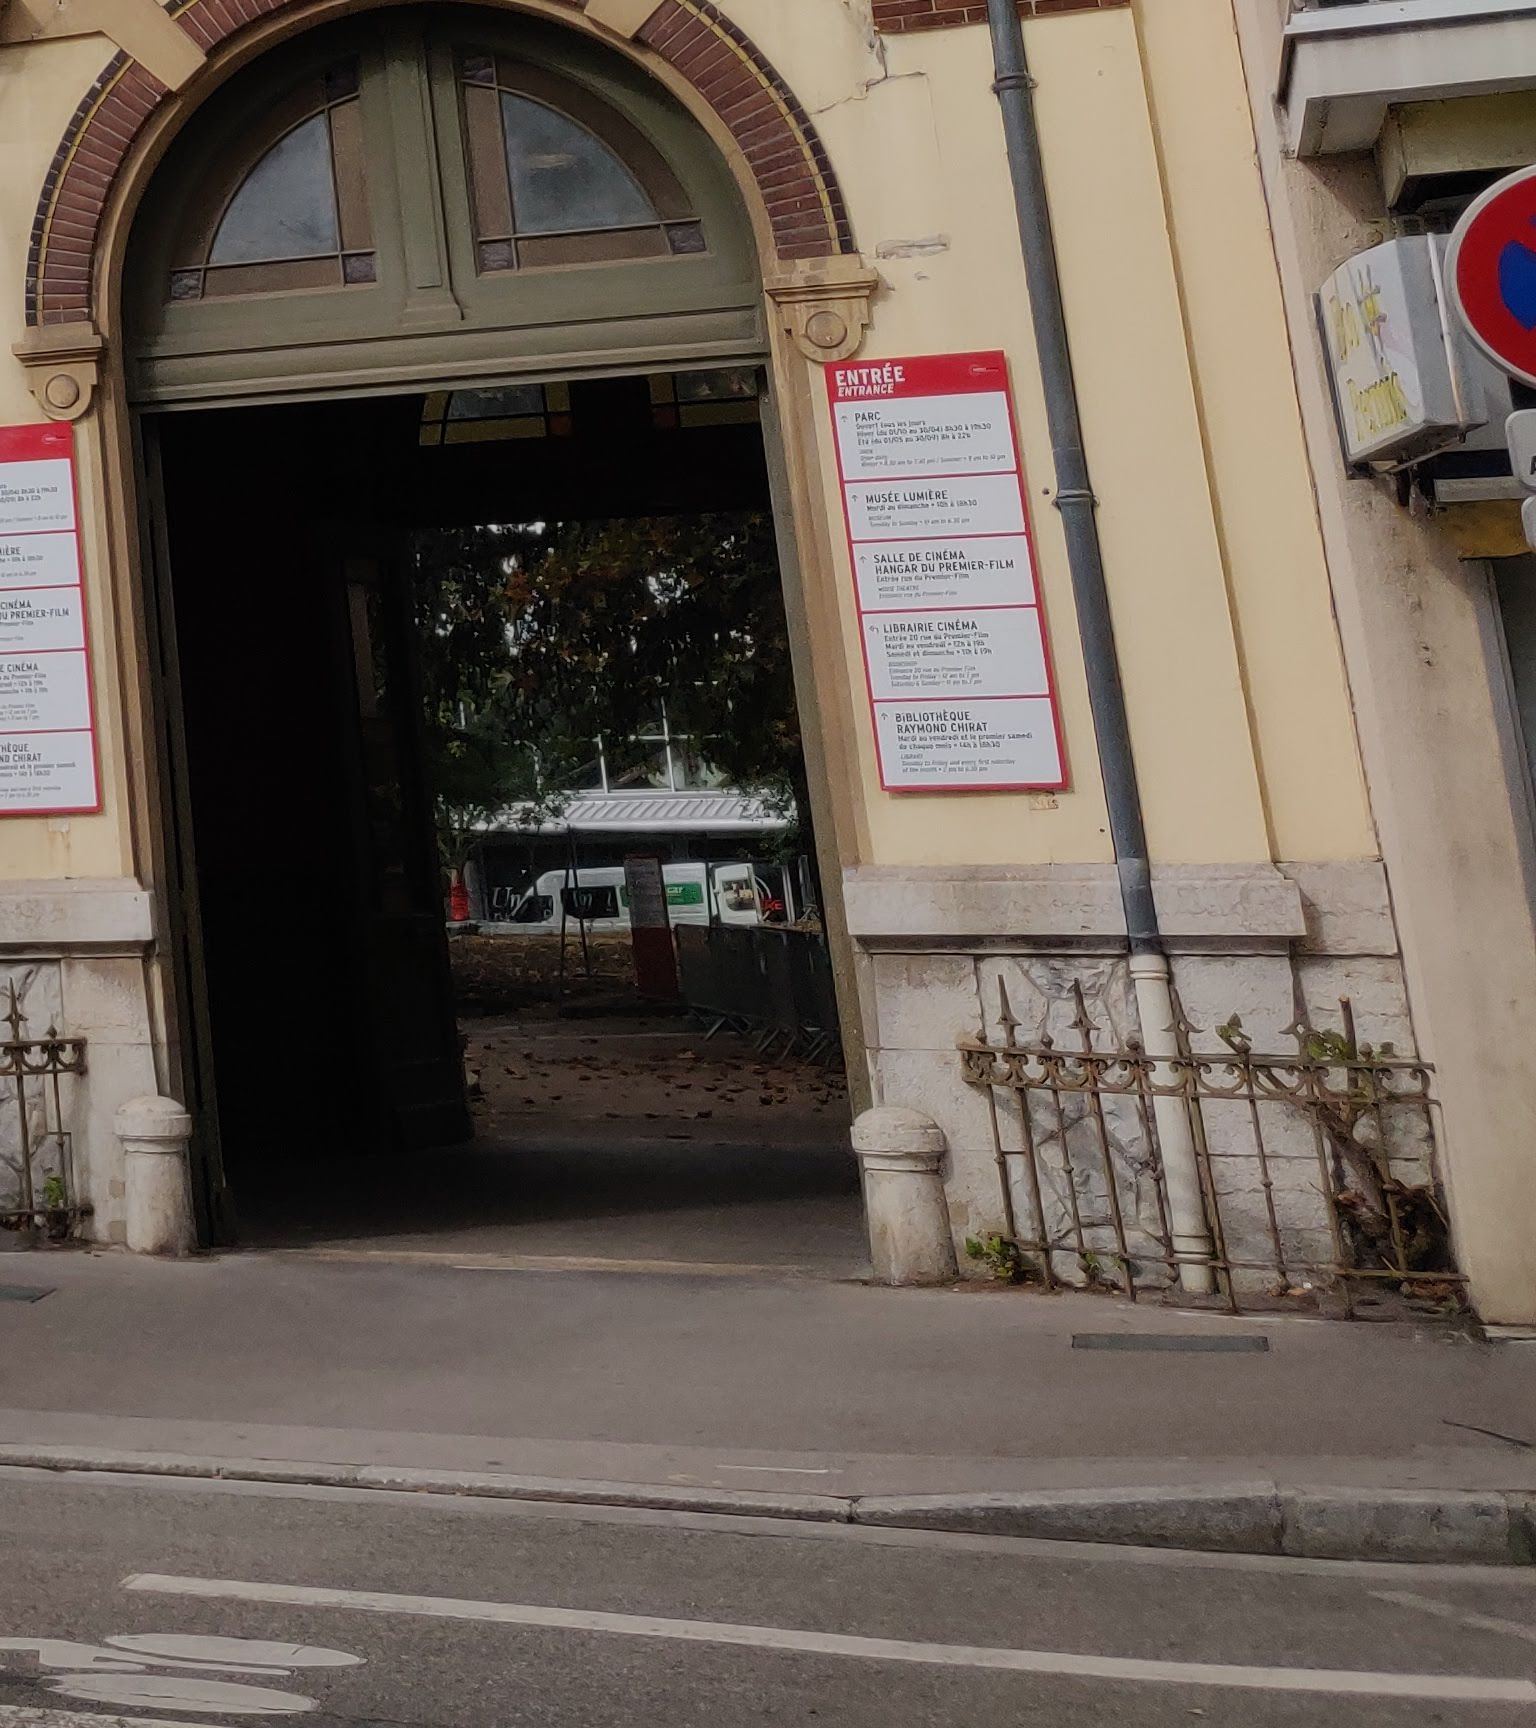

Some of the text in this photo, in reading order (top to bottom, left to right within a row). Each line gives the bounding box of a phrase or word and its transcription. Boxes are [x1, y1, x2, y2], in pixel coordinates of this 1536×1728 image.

[835, 362, 905, 386] ENTRÉE
[838, 383, 894, 397] ENTRANCE
[855, 412, 881, 422] PARC
[866, 489, 948, 503] MUSÉE LUMIÈRE
[874, 548, 965, 564] SALLE DE CINÉMA
[876, 559, 1014, 574] HANGAR DU PREMIER-FILM
[0, 598, 31, 609] CINÉMA
[11, 608, 69, 619] PREMIER-FILM
[884, 619, 978, 633] LIBRAIRIE CINÉMA
[7, 662, 38, 672] CINÉMA
[896, 709, 971, 722] BIBLIOTHÈQUE
[897, 722, 988, 734] RAYMOND CHIRAT
[12, 753, 41, 762] CHIRAT
